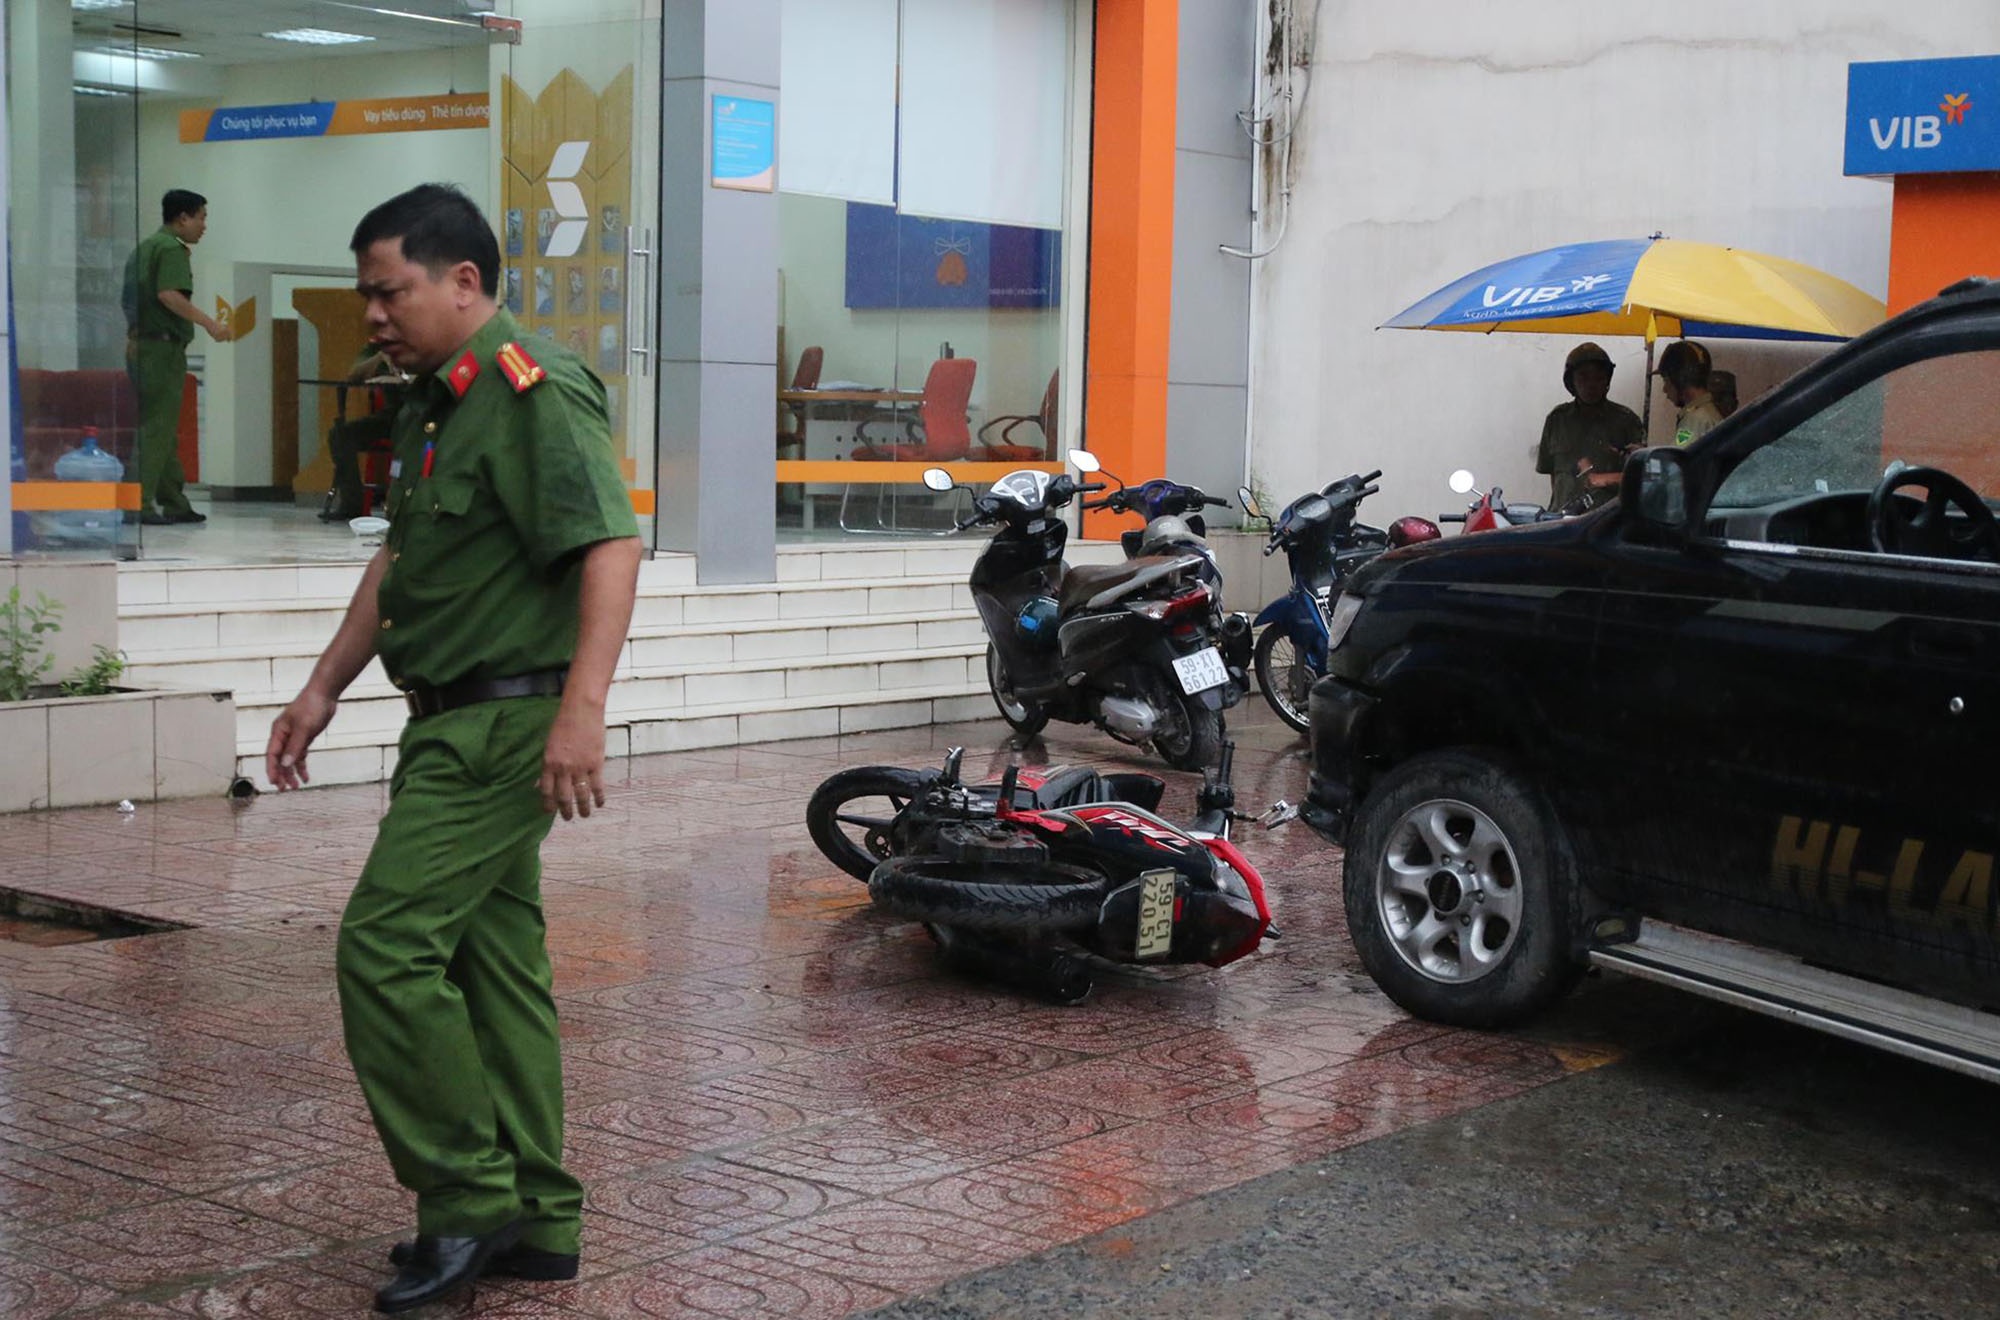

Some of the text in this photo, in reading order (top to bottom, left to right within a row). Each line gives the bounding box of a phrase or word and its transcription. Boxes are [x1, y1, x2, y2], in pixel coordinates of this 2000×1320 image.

[221, 115, 251, 132] Chúng
[251, 114, 262, 129] tôi
[363, 109, 380, 124] Vay
[401, 106, 426, 122] dùng
[1869, 115, 1942, 150] VIB
[1482, 285, 1566, 308] VIB
[1182, 666, 1227, 692] 561.22
[1768, 815, 2000, 932] HI-LA
[1155, 882, 1173, 940] 59-C1
